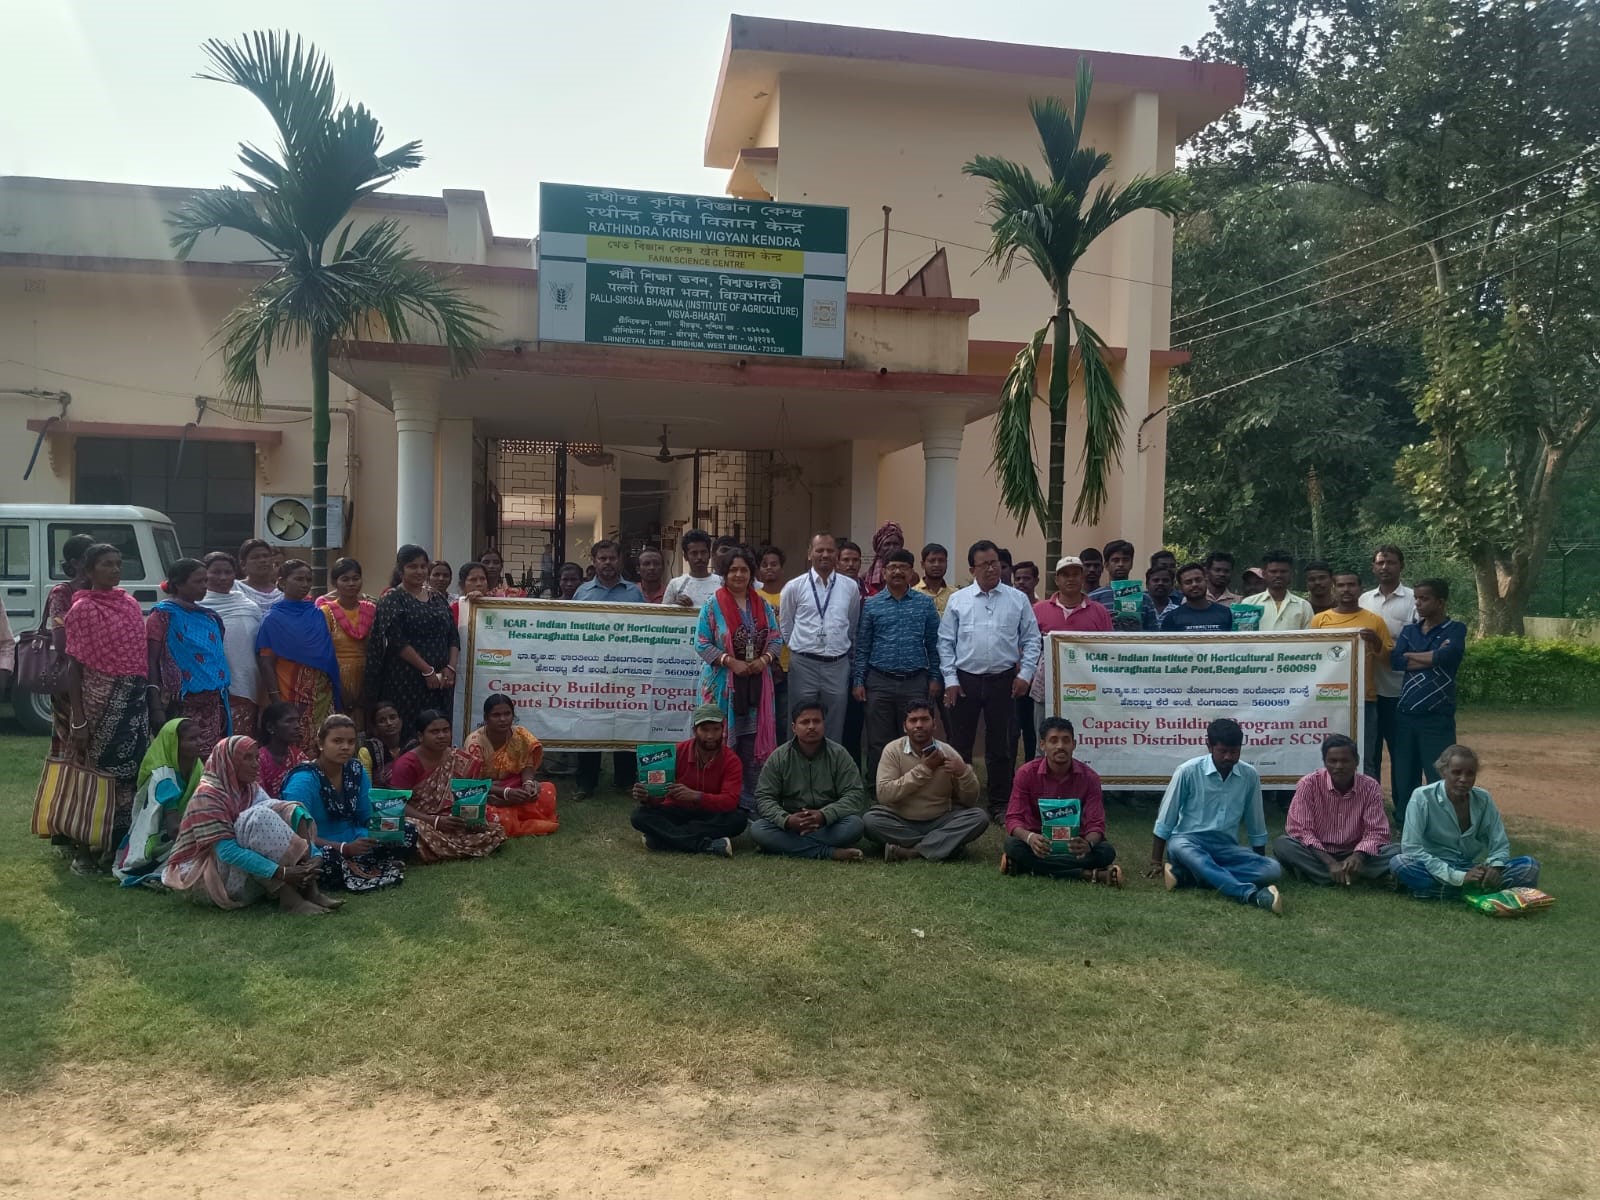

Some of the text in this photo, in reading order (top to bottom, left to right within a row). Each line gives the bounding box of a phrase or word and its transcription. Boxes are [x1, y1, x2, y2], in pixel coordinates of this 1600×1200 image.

[585, 190, 806, 218] রথীন্দ্র কৃষি বিজ্ঞান কেন্দ্র
[584, 205, 805, 234] रथीन्द्र कृषि विज्ञान केन्द्र
[589, 221, 801, 247] RATHINDRA KRISHI VIGYAN KENDRA
[649, 254, 745, 269] FARM SCIENCE CENTRE
[724, 247, 755, 260] विज्ञान
[760, 249, 783, 262] केन्द्र
[608, 281, 639, 294] पल्ली
[643, 283, 675, 296] शिक्षा
[719, 288, 782, 304] विश्वभारती
[590, 293, 799, 318] PALLI-SIKSHA BHAVANA (INSTITUTE OF AGRICULTURE)
[667, 310, 726, 322] VISVA-BHARATI
[707, 342, 726, 350] WEST
[728, 343, 756, 352] BENGAL
[503, 619, 527, 628] ICAR
[536, 620, 567, 629] Indian
[570, 621, 610, 631] Institute
[613, 623, 625, 631] Of
[627, 623, 688, 634] Horticultural
[508, 630, 580, 642] Hessaraghatta
[582, 633, 605, 642] Lake
[1085, 652, 1108, 661] ICAR
[1118, 653, 1149, 662] Indian
[1152, 653, 1194, 662] Institute
[1196, 653, 1208, 662] Of
[1210, 652, 1274, 662] Horticultural
[1277, 652, 1323, 661] Research
[664, 668, 700, 677] 560089
[1091, 664, 1161, 675] Hessaraghatta
[1164, 665, 1188, 674] Lake
[1276, 664, 1317, 673] 560089
[488, 679, 562, 696] Capacity
[567, 681, 636, 698] Building
[548, 696, 648, 711] Distribution
[654, 699, 698, 712] Unde
[1252, 699, 1290, 707] 560089
[1082, 716, 1150, 733] Capacity
[1299, 716, 1328, 729] and
[1078, 733, 1128, 749] Inputs
